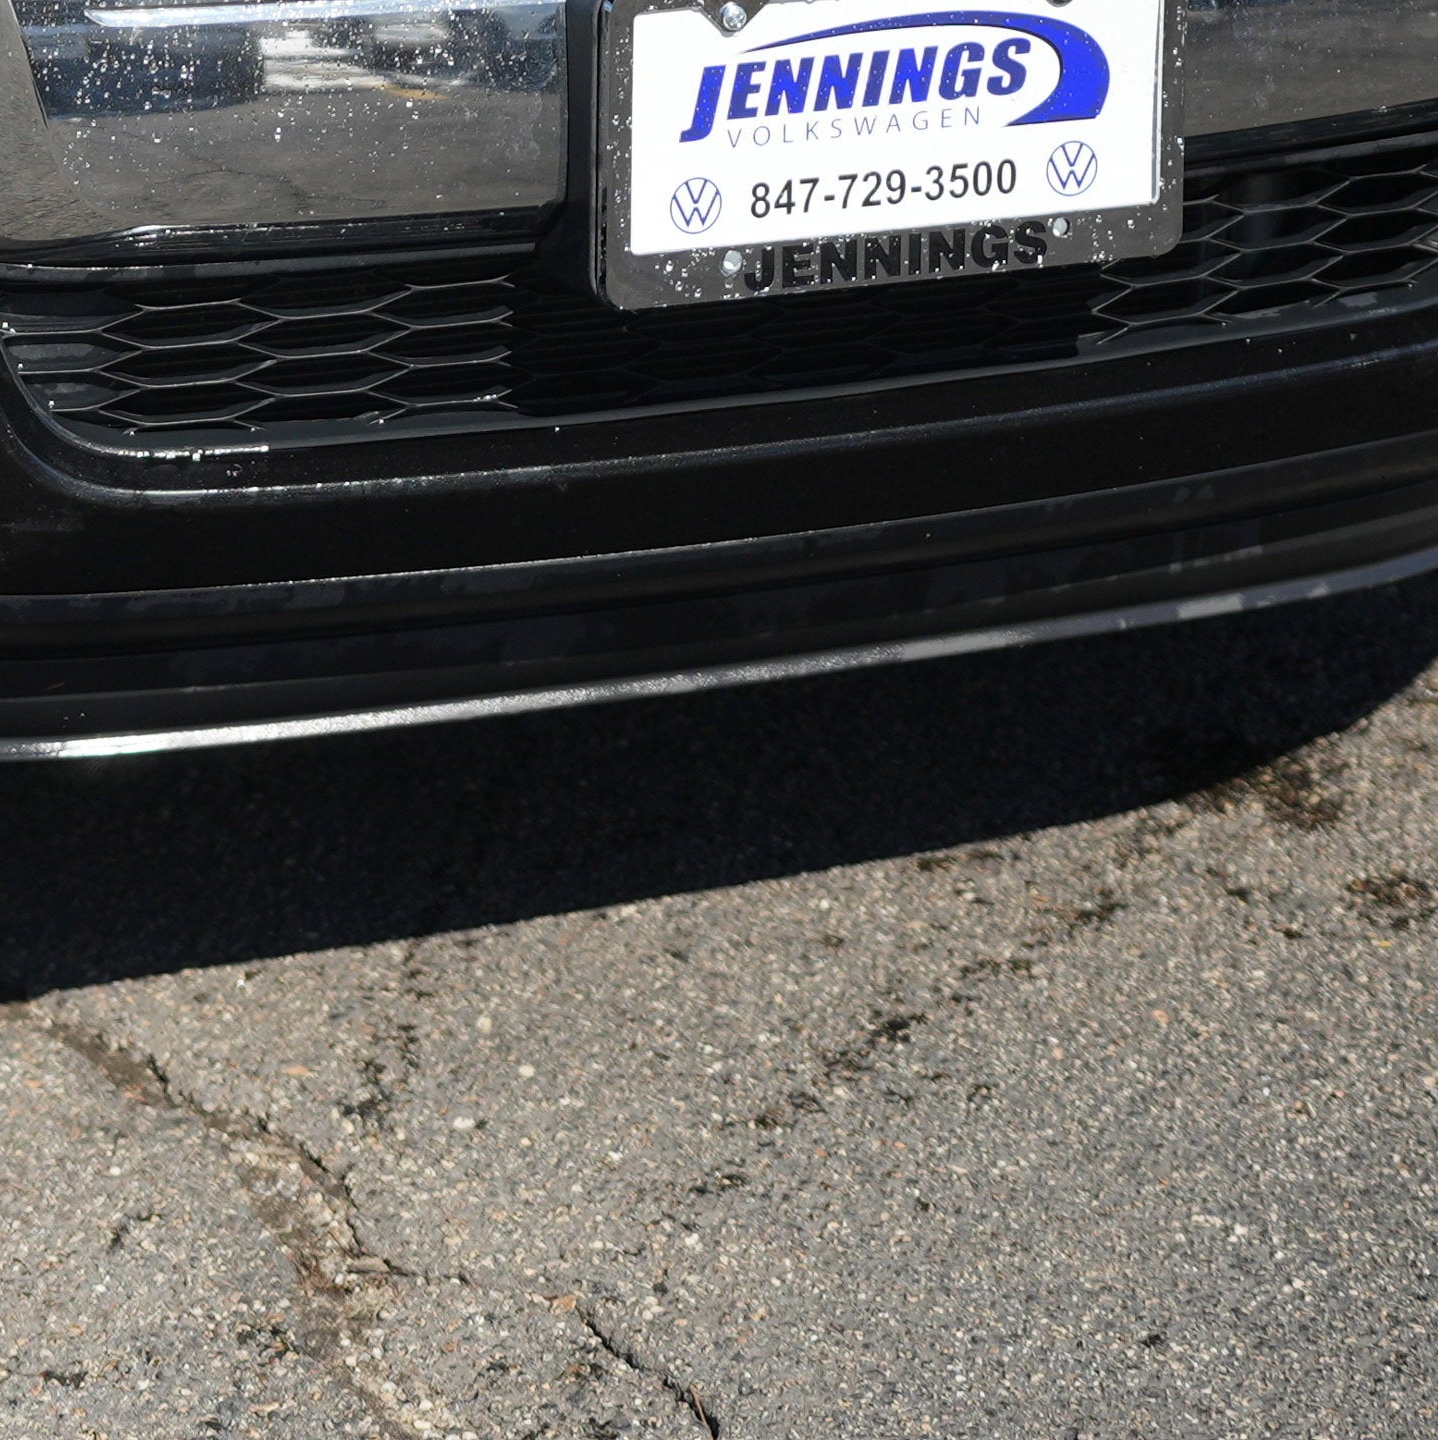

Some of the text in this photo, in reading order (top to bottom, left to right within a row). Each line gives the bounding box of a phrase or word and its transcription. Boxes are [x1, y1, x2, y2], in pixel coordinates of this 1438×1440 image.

[678, 37, 1033, 144] JENNINGS
[726, 106, 983, 149] VOLKSWAGEN
[749, 158, 1018, 219] 847-729-3500
[743, 219, 1050, 294] JENNINGS
